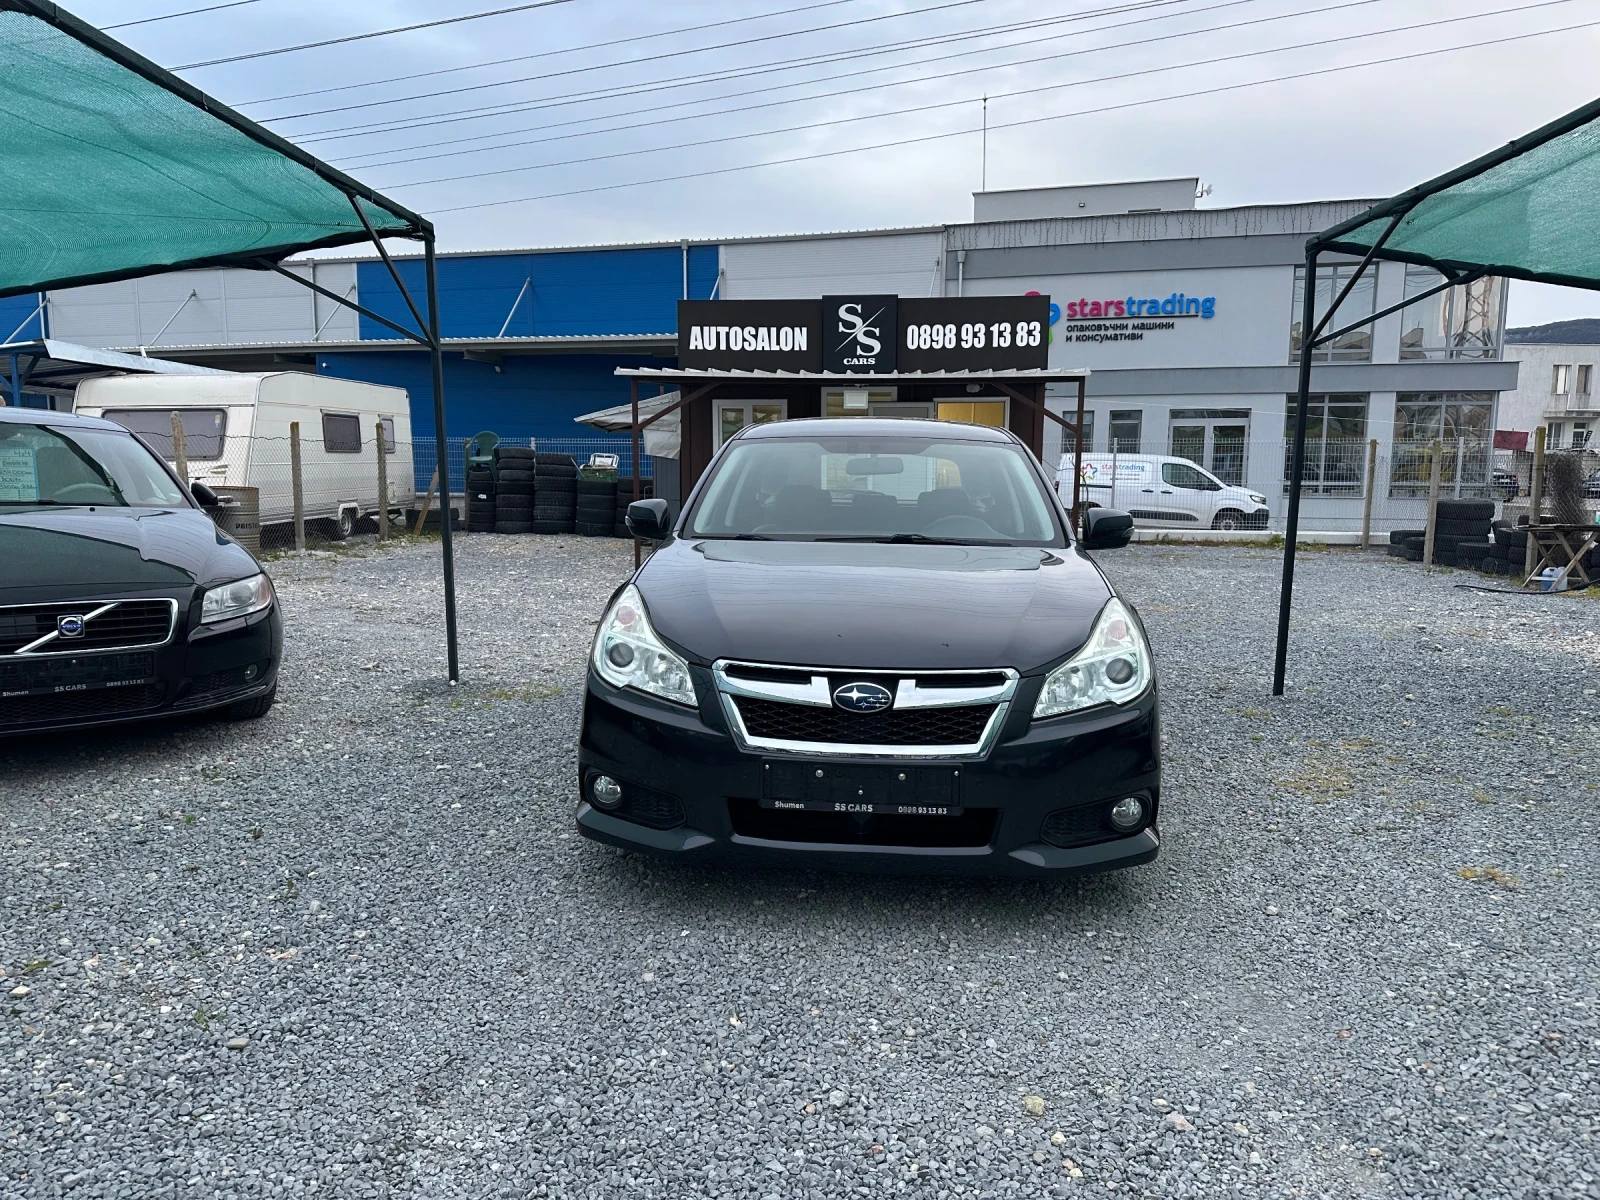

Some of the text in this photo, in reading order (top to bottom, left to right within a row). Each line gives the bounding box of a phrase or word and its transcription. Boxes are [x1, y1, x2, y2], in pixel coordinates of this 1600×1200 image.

[1067, 293, 1216, 319] starstrading
[1066, 321, 1174, 333] опаковъчни машини
[689, 326, 808, 351] AUTOSALON
[906, 321, 1041, 350] 0898 93 13 83
[1075, 332, 1143, 343] консумативи
[843, 357, 876, 365] CARS
[1101, 463, 1145, 472] stastrading
[775, 800, 805, 809] Shumen
[834, 803, 846, 811] SS
[847, 803, 873, 812] CARS
